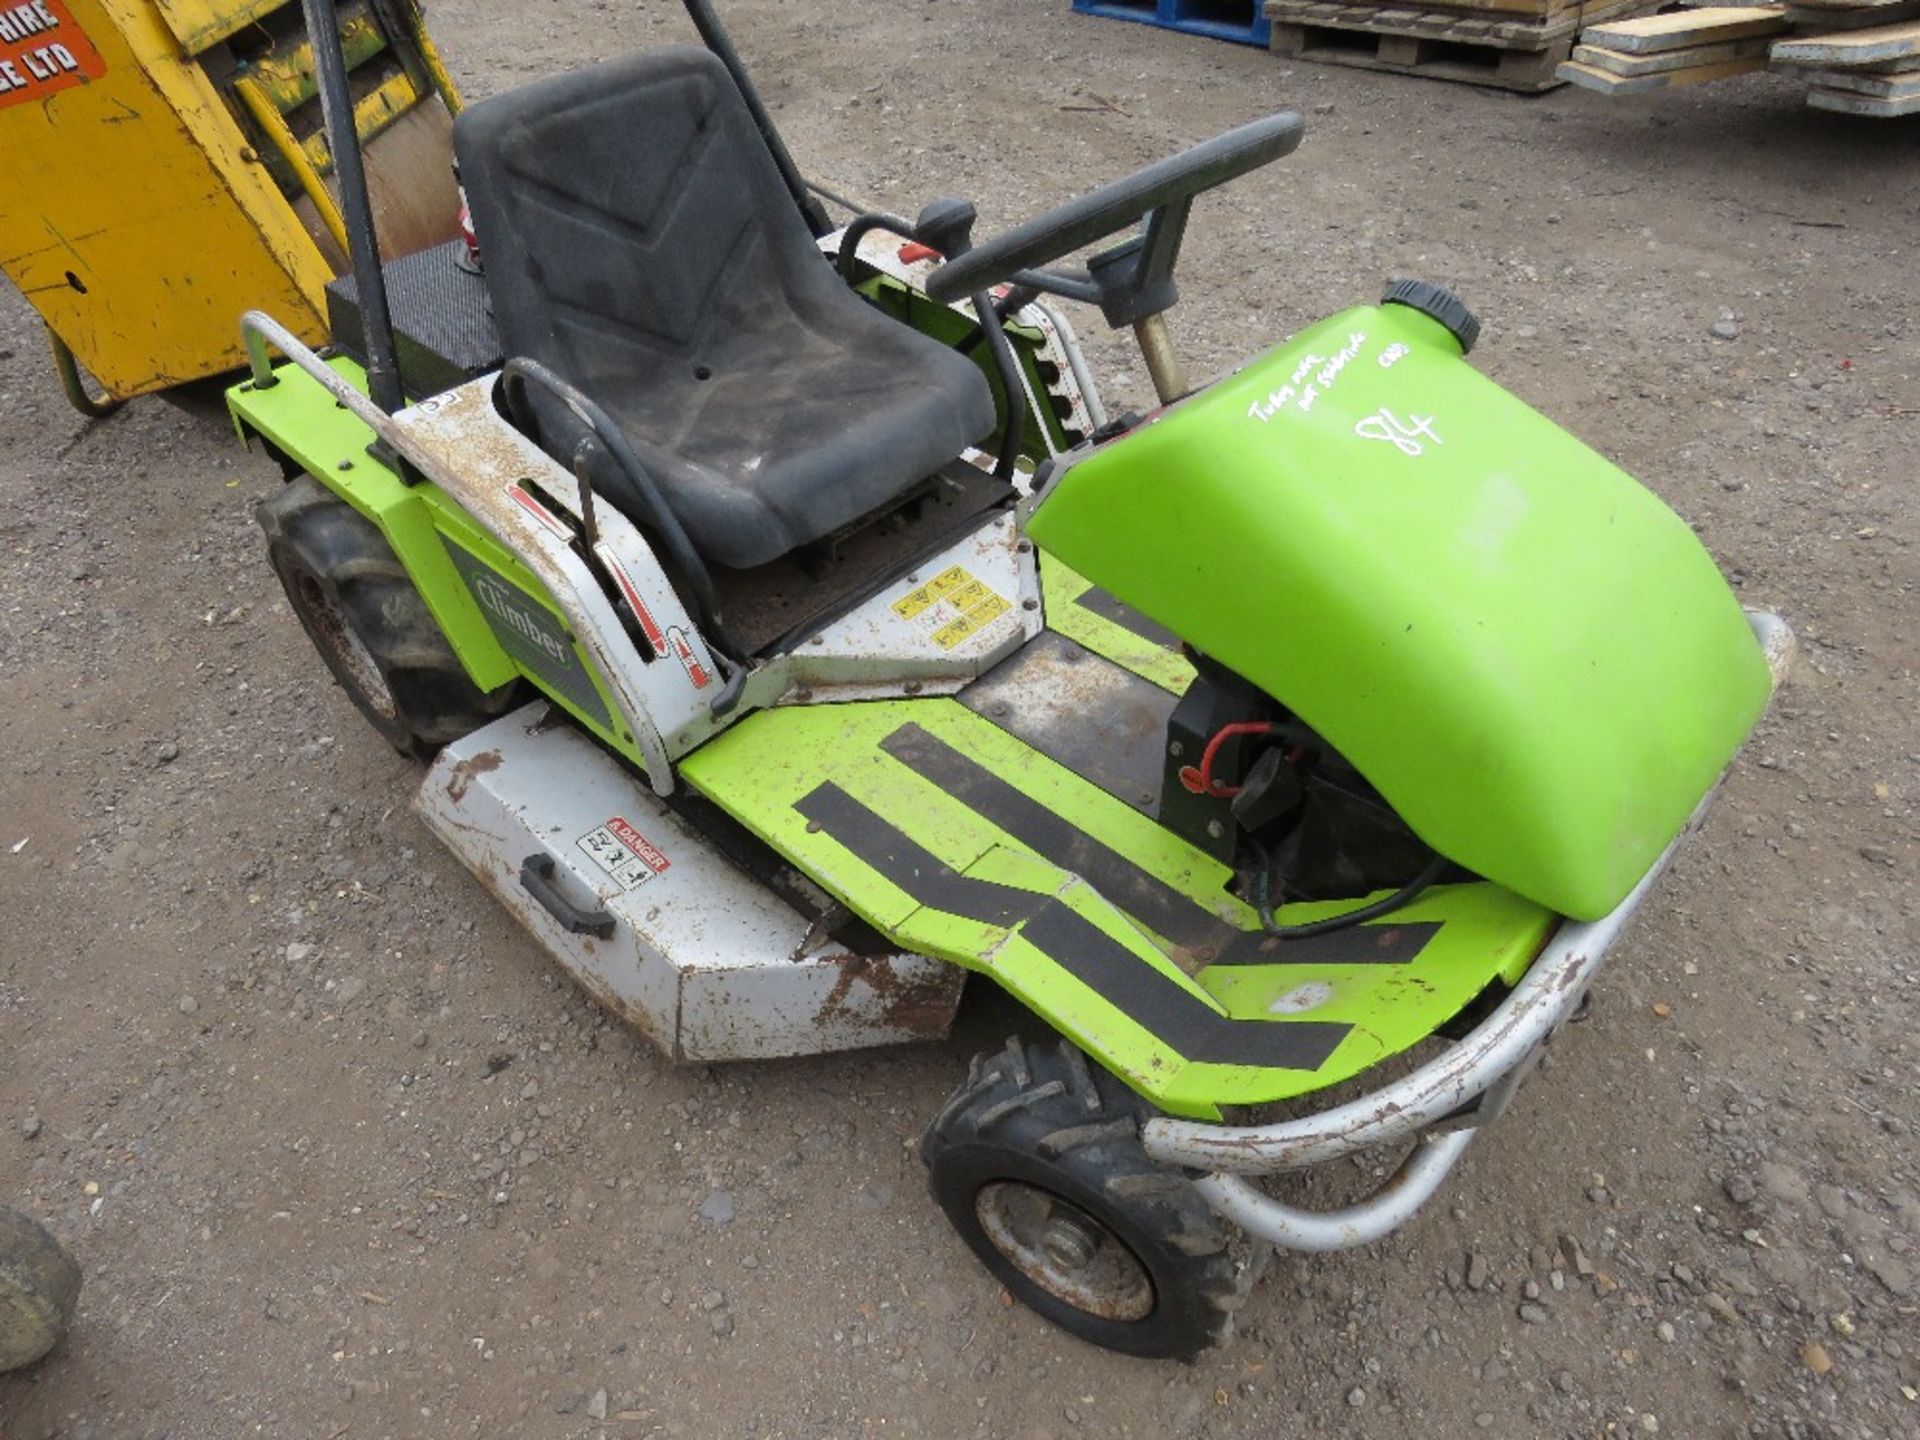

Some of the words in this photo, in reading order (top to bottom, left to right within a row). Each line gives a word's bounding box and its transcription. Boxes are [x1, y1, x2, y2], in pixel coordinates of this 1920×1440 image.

[0, 0, 59, 42] HIRE
[20, 42, 78, 82] LTD
[475, 578, 566, 664] Climber
[616, 827, 665, 868] DANGER
